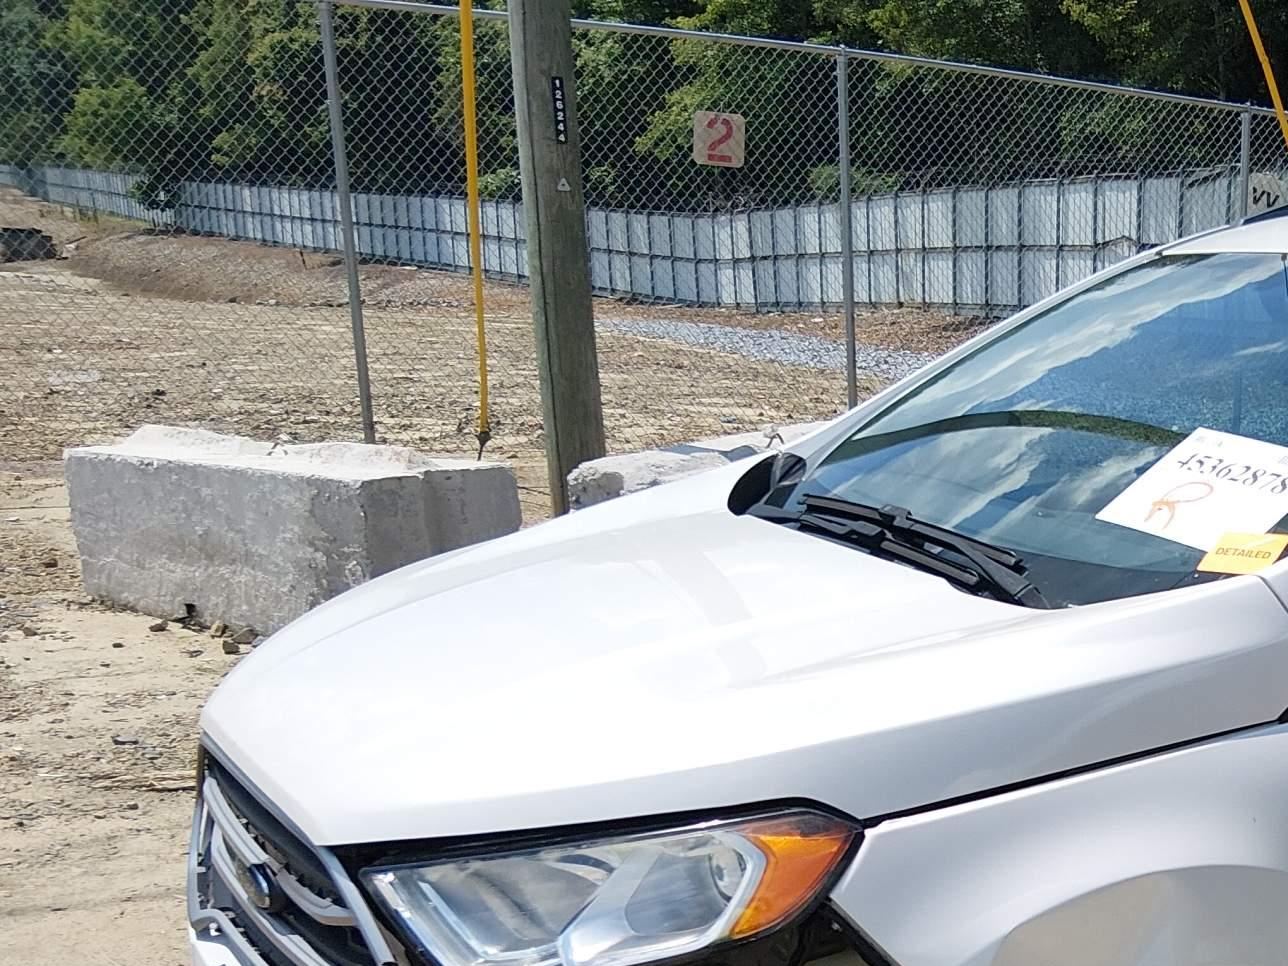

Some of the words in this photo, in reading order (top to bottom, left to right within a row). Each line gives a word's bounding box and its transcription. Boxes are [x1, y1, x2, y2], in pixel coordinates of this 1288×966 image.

[554, 78, 567, 143] 126244
[705, 114, 734, 163] 2
[1214, 545, 1272, 561] DETAILED
